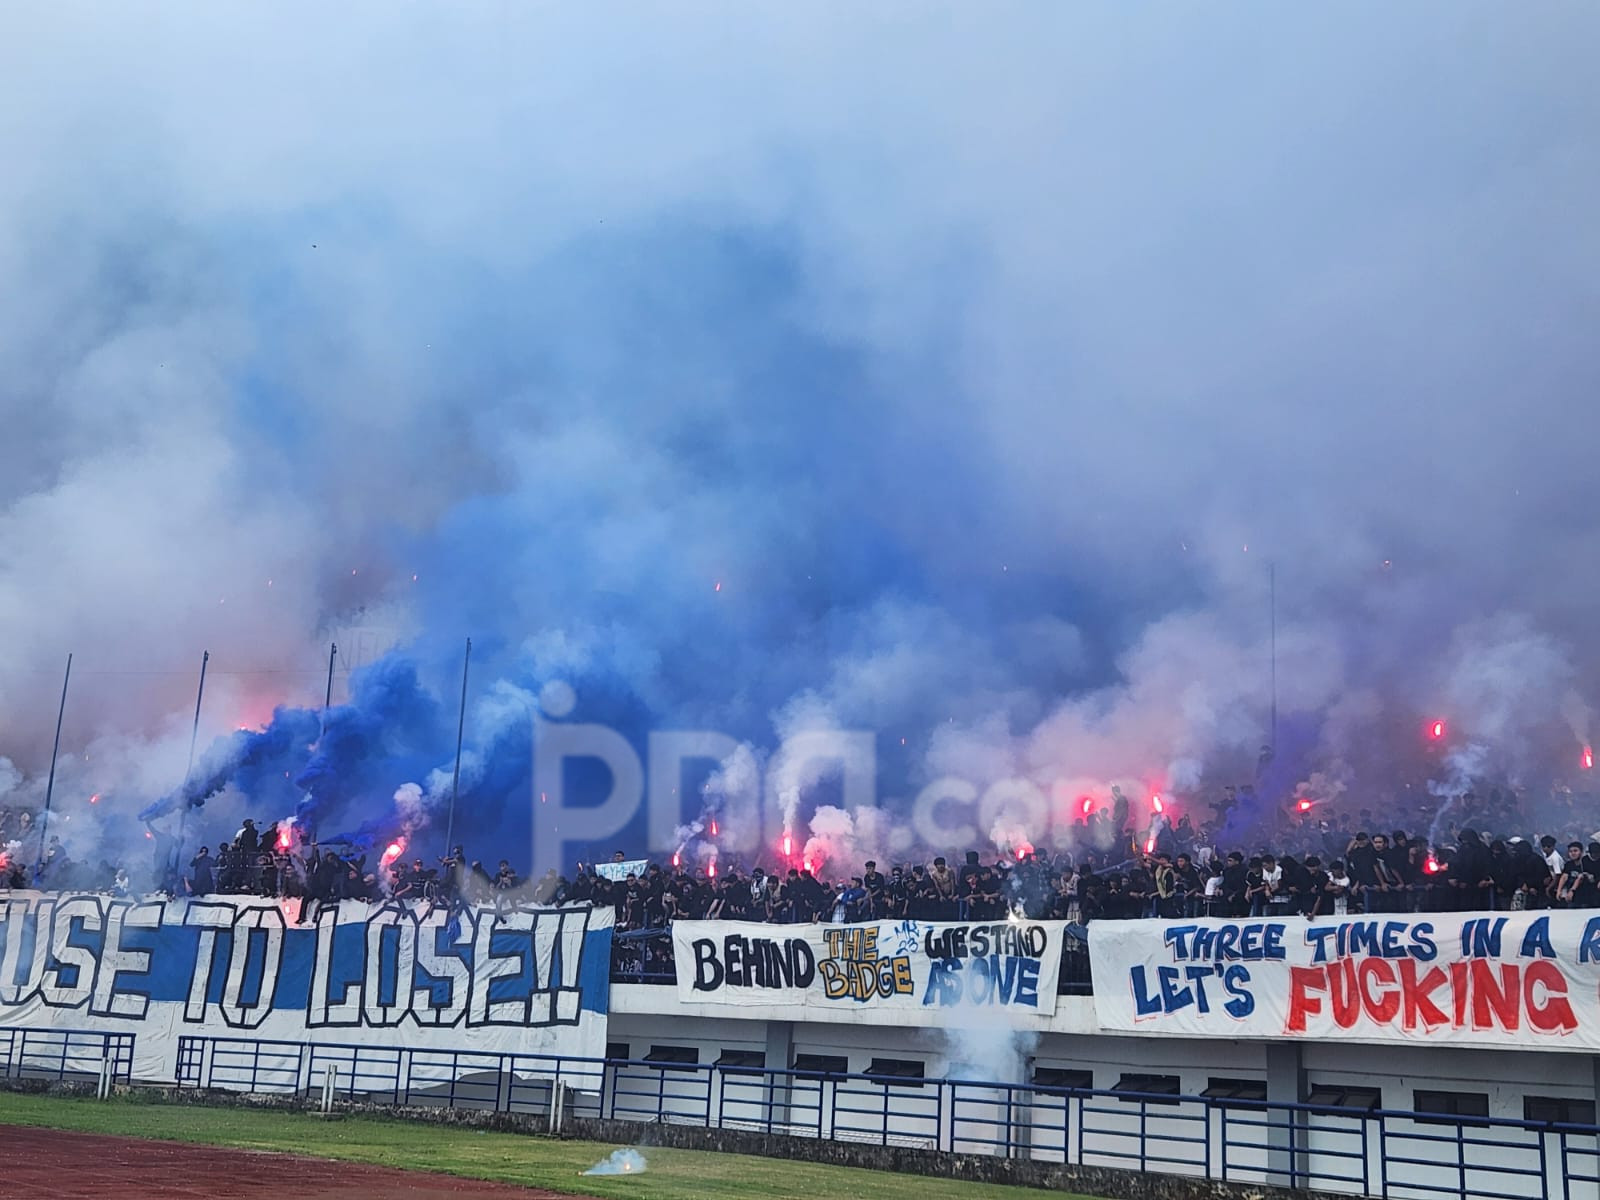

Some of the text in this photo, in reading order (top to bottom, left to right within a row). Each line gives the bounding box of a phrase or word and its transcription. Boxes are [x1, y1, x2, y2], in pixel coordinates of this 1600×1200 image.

[0, 895, 593, 1029] USE TO LOSE!!
[692, 934, 815, 992] BEHIND
[823, 926, 880, 961] THE
[1164, 923, 1286, 962] THREE
[1304, 922, 1438, 964] TIMES
[1460, 917, 1509, 957] IN
[1517, 915, 1558, 962] A
[817, 956, 914, 1003] BADGE
[968, 954, 1041, 1007] ONE
[1129, 963, 1256, 1022] LET'S
[1283, 957, 1579, 1036] FUCKING
